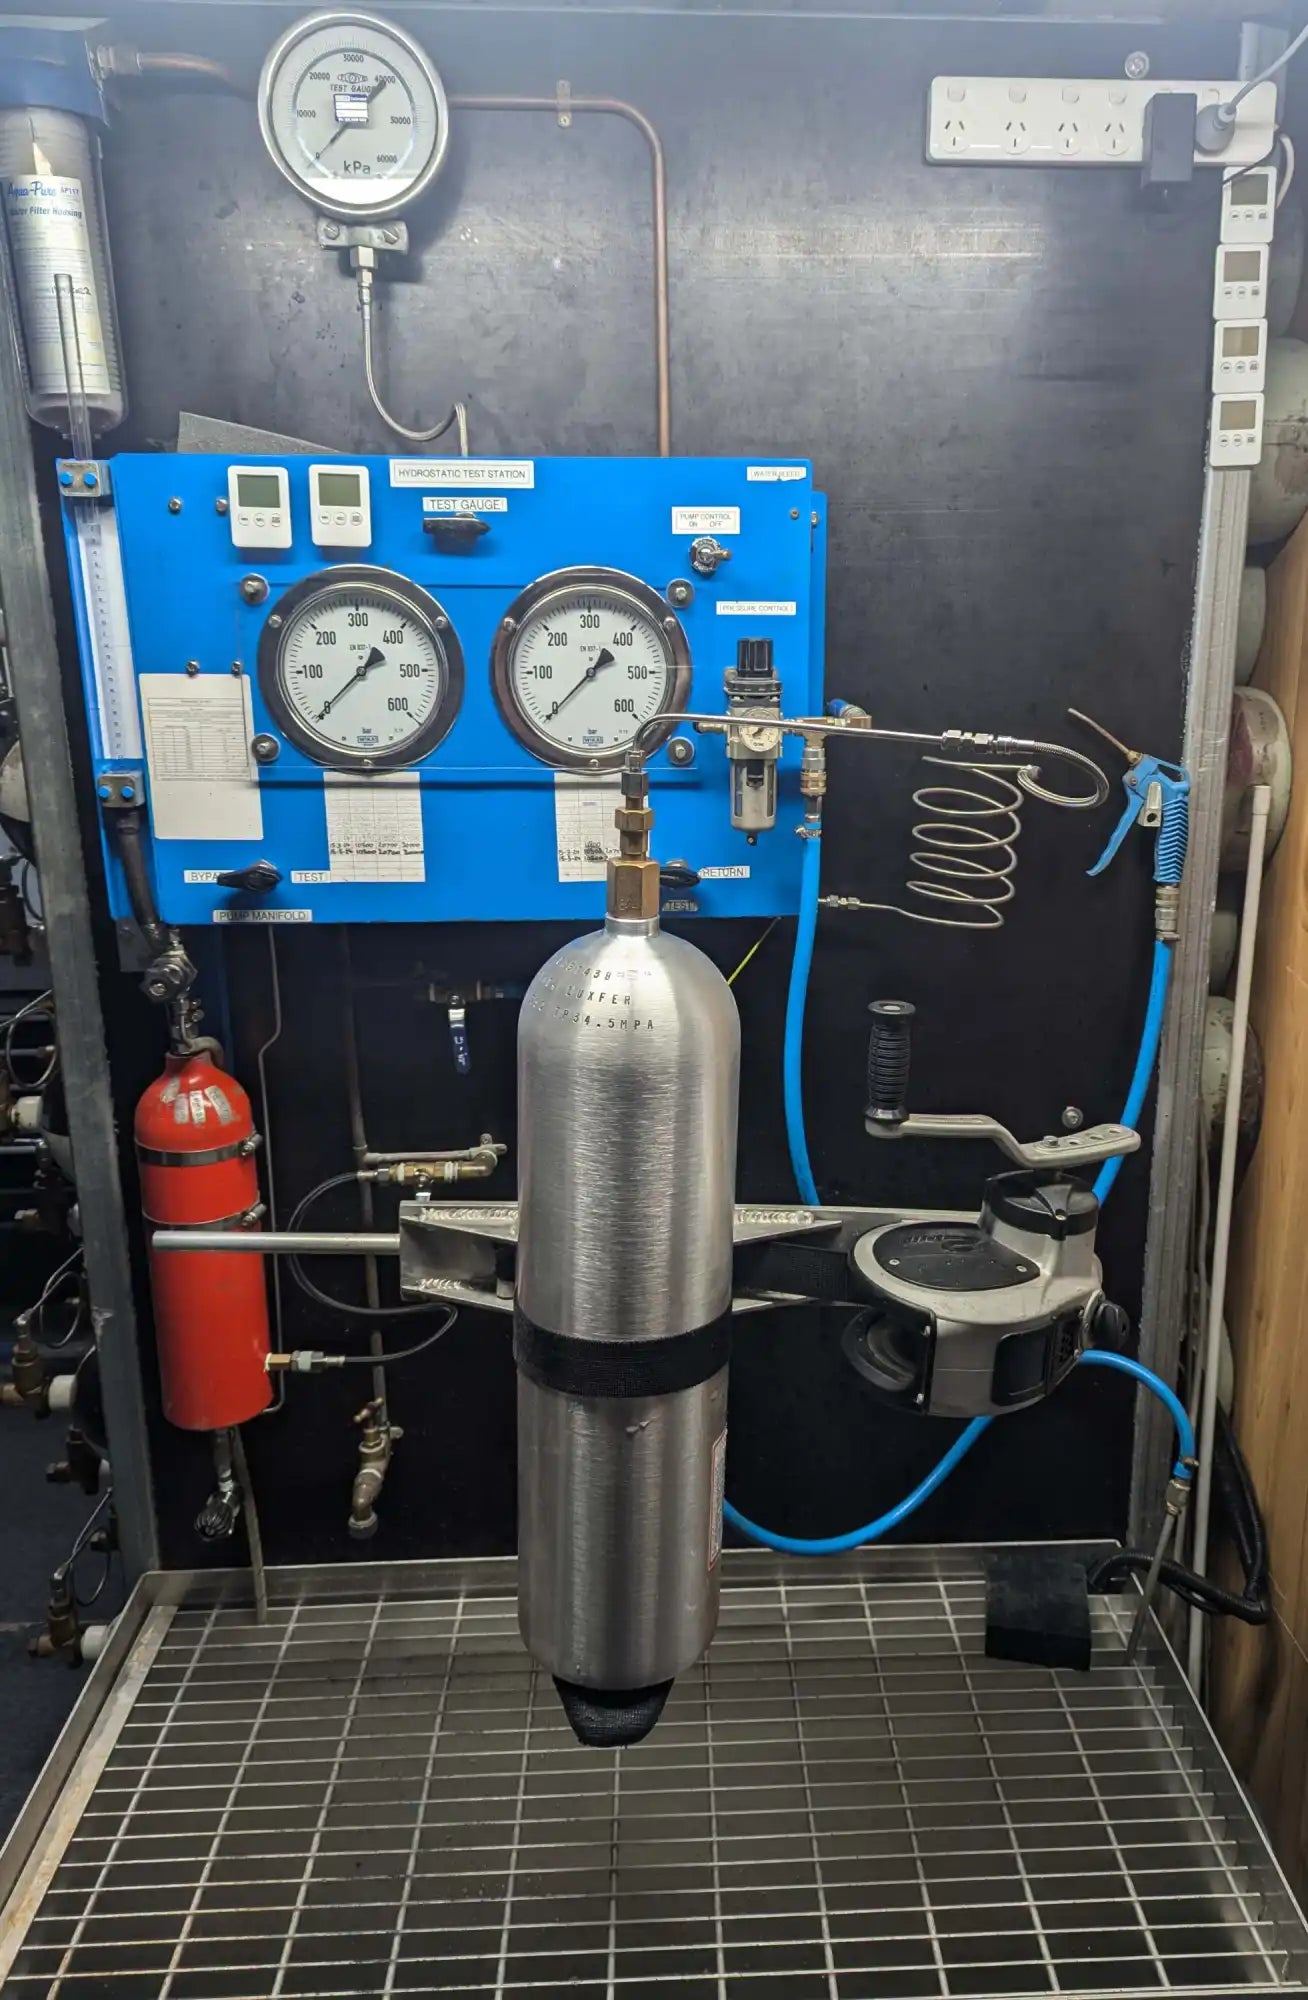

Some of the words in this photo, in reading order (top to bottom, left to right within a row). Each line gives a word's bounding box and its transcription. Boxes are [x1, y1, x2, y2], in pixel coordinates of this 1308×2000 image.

[343, 54, 364, 63] 30000
[309, 72, 331, 80] 20000
[330, 84, 348, 93] TEST
[351, 85, 374, 93] GAUG
[390, 116, 411, 124] 50000
[377, 155, 398, 163] 60000
[343, 161, 371, 174] kPa
[52, 207, 82, 219] Housing
[398, 469, 461, 478] HYDROSTATIC
[463, 470, 486, 478] TEST
[487, 470, 526, 479] STATION
[429, 499, 457, 510] TEST
[460, 499, 501, 510] GAUGE
[348, 613, 368, 627] 300
[580, 614, 600, 628] 300
[316, 631, 336, 645] 200
[383, 630, 403, 644] 400
[547, 632, 567, 646] 200
[613, 632, 633, 646] 400
[302, 664, 323, 678] 100
[400, 664, 420, 677] 500
[533, 665, 552, 679] 100
[627, 666, 647, 679] 500
[324, 701, 331, 714] 0
[388, 698, 408, 711] 600
[552, 701, 558, 714] 0
[614, 699, 634, 712] 600
[191, 872, 219, 881] BYPA
[297, 872, 324, 881] TEST
[703, 868, 744, 877] RETURN
[220, 911, 249, 920] PUMP
[252, 911, 306, 920] MANIFOLD
[565, 985, 631, 1005] LUXFER
